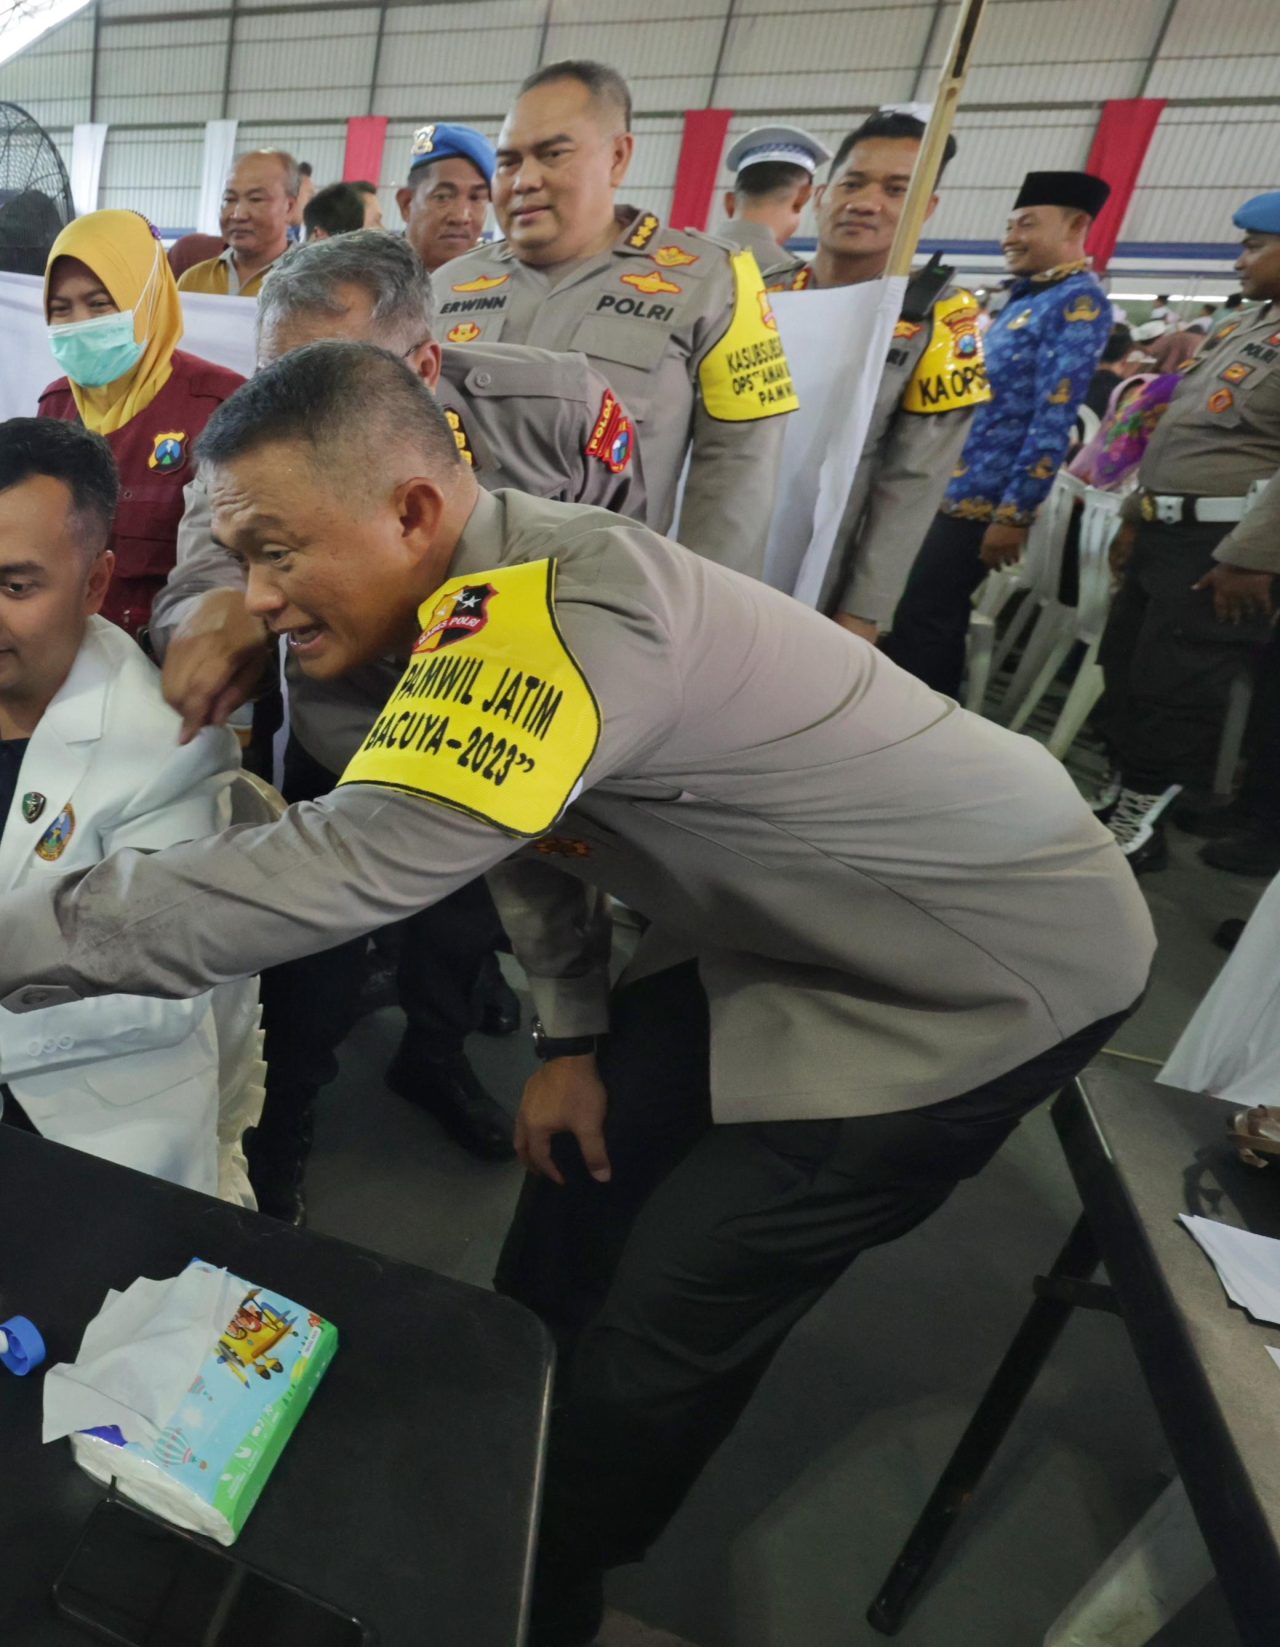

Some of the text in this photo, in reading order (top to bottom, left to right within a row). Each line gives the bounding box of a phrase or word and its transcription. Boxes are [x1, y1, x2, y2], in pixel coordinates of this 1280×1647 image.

[439, 295, 507, 315] ERWINN
[596, 295, 675, 322] POLRI
[918, 374, 950, 407] KA
[590, 399, 613, 449] POLDA
[448, 616, 481, 627] POLRI
[391, 655, 564, 741] PAMWIL JATIM
